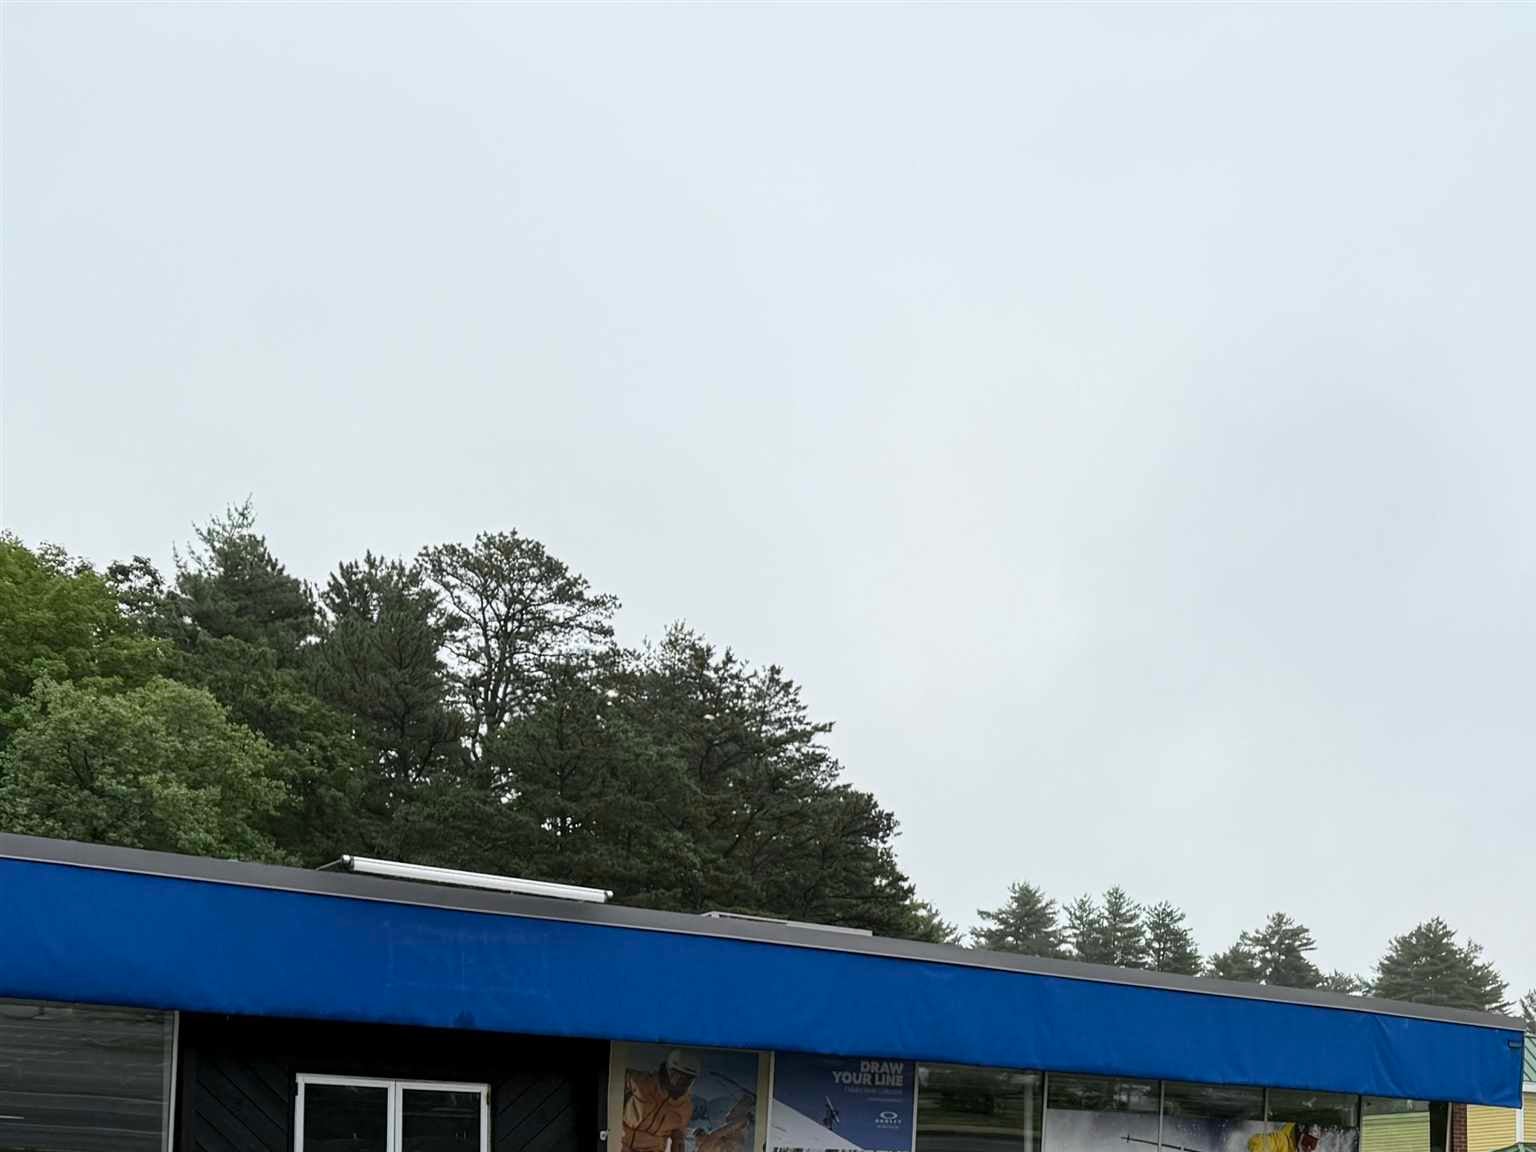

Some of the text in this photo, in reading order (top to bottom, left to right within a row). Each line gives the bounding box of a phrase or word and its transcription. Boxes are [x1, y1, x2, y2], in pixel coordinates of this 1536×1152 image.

[861, 1061, 904, 1074] DRAW
[832, 1071, 903, 1087] YOUR LINE
